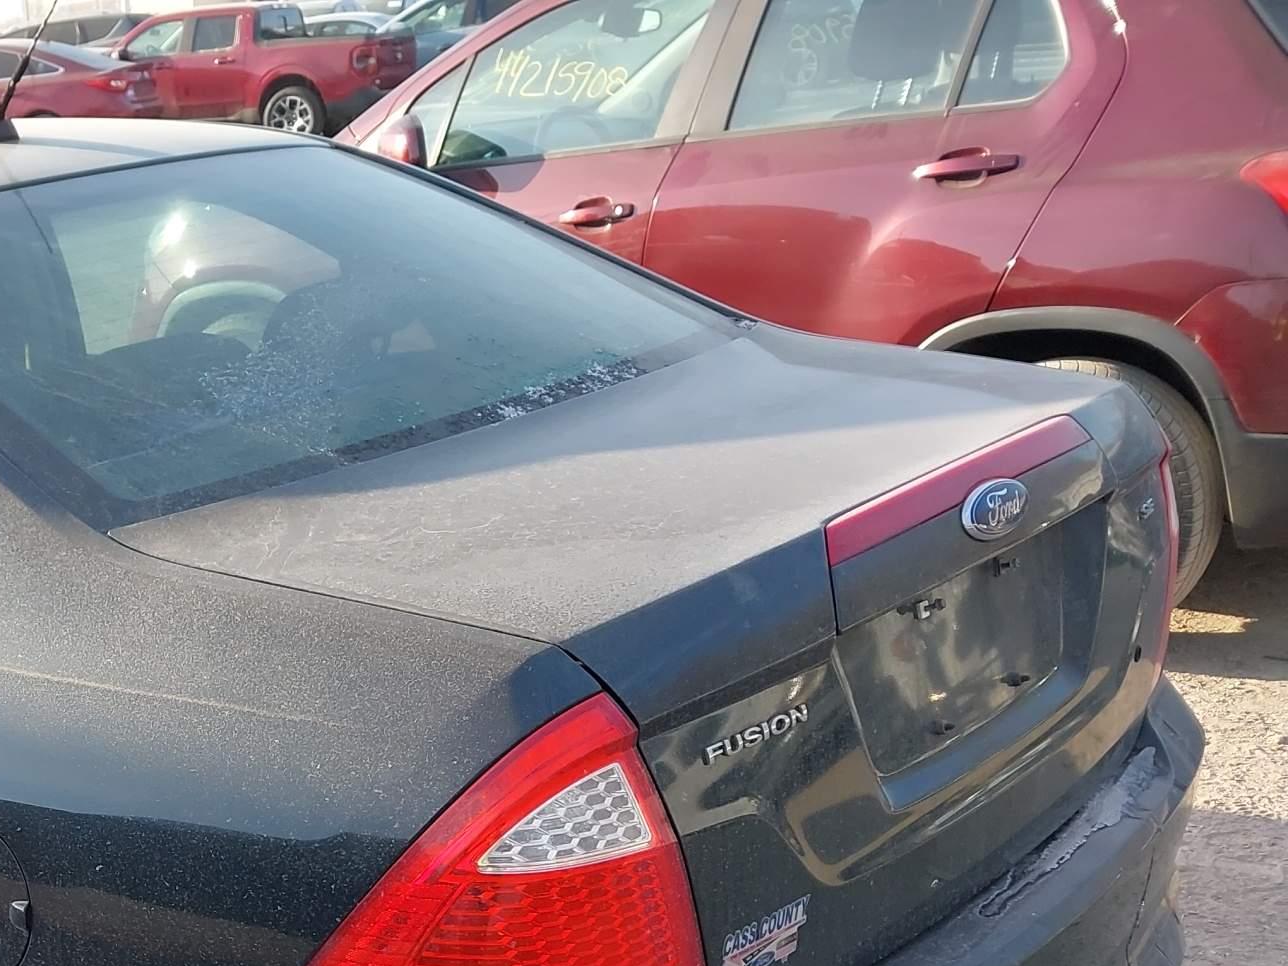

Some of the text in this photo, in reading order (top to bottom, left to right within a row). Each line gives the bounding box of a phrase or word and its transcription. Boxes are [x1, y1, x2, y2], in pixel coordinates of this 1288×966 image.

[495, 48, 630, 102] 44215908
[703, 703, 808, 765] FUSION
[723, 893, 811, 957] CASS COUNTY
